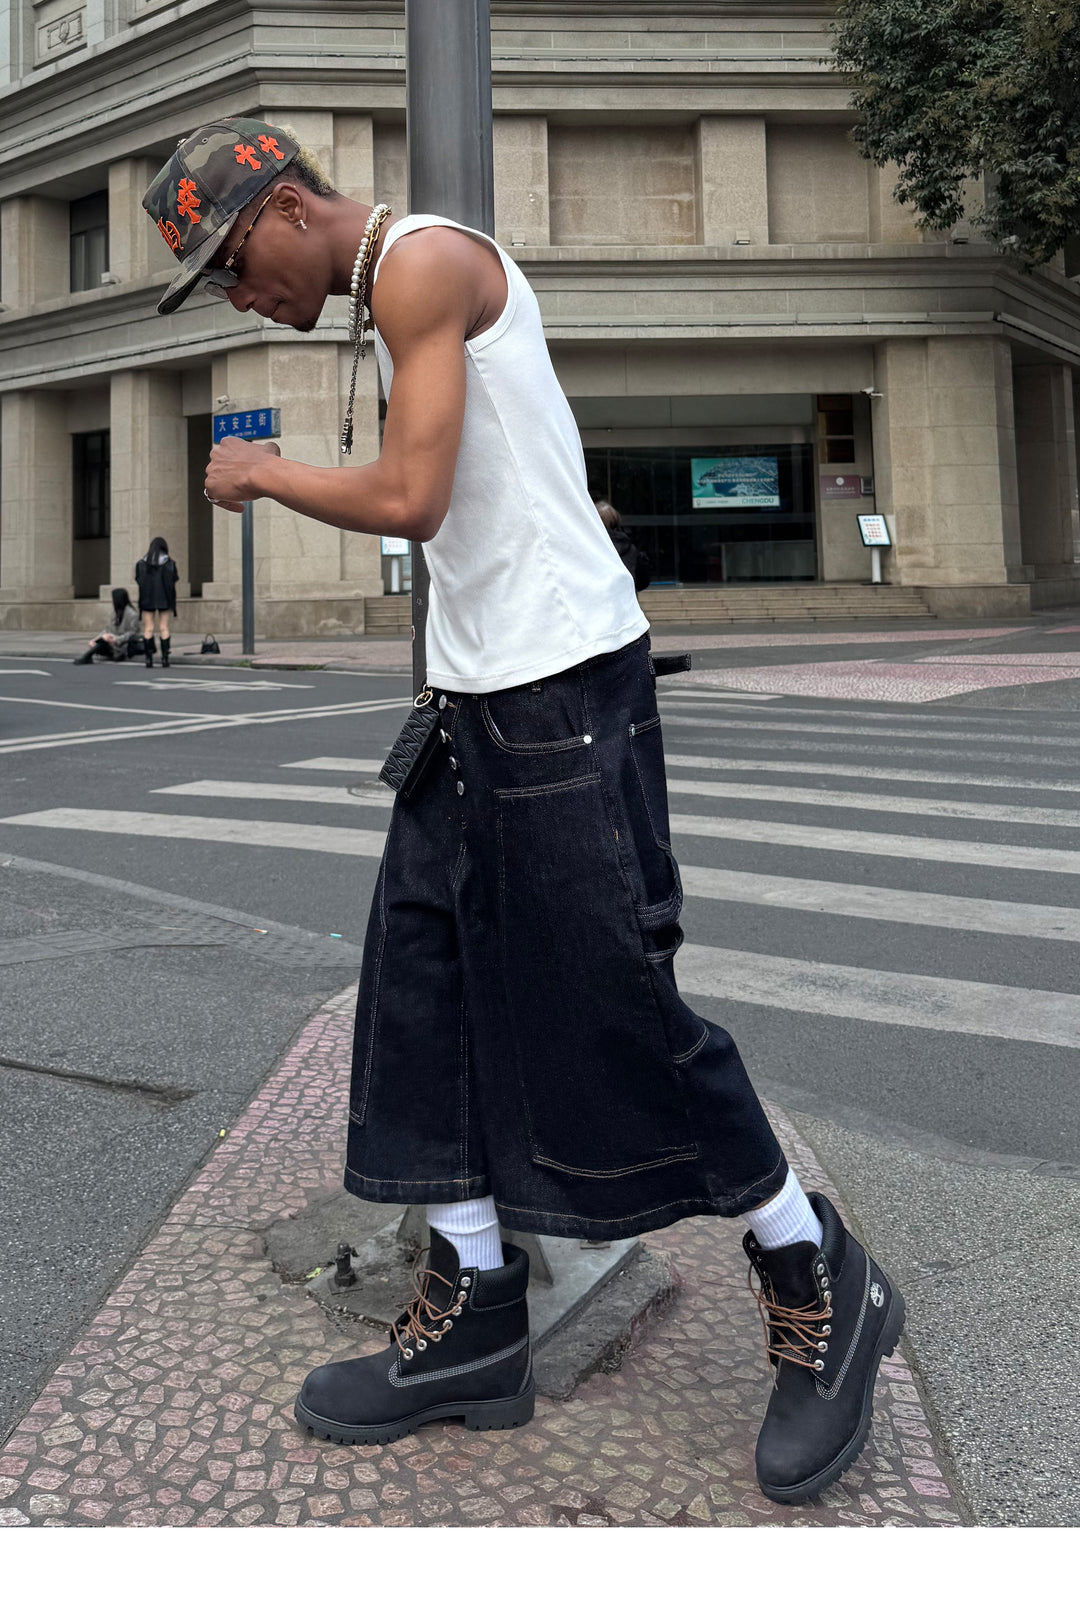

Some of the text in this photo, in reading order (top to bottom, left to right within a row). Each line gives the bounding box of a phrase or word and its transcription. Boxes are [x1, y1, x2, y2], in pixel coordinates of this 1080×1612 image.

[219, 413, 266, 432] 大安正街
[741, 497, 774, 505] CHENGDU
